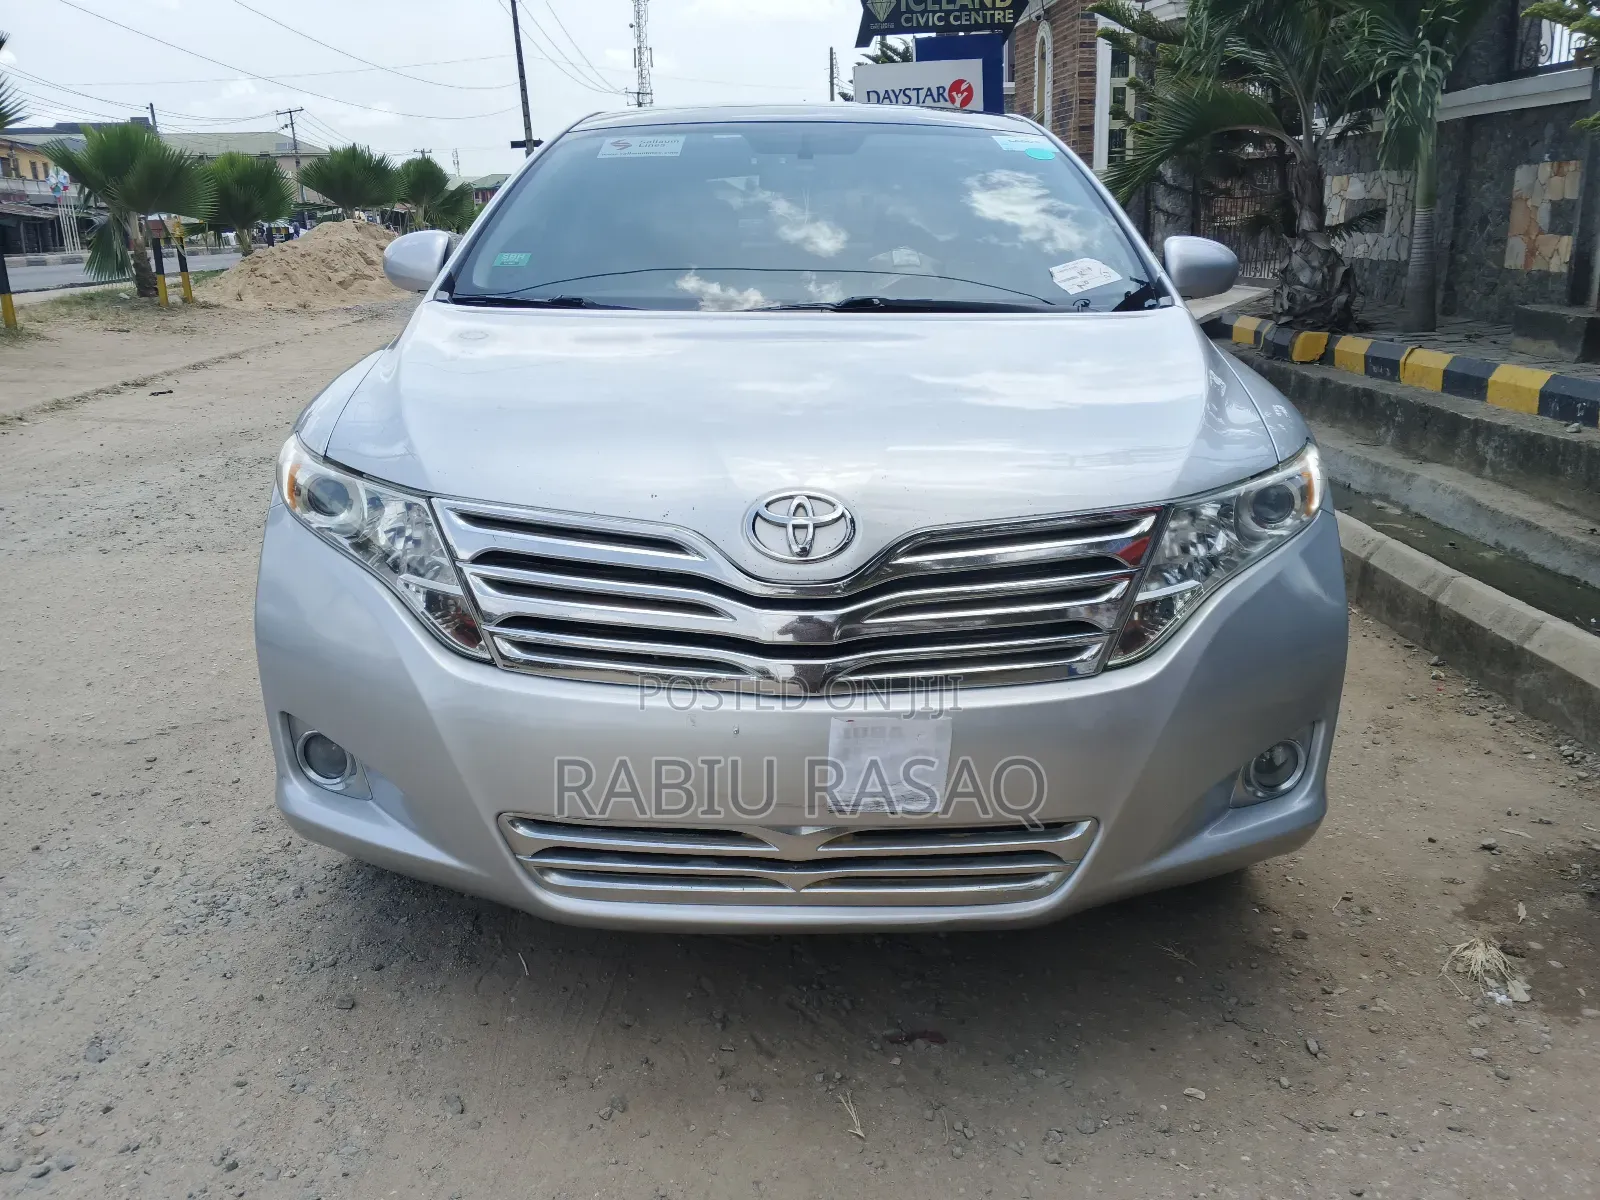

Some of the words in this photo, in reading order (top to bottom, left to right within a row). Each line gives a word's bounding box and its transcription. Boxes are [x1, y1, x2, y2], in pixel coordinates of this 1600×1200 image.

[901, 13, 945, 27] CIVIC
[950, 10, 1013, 25] CENTRE
[866, 86, 948, 104] DAYSTAR
